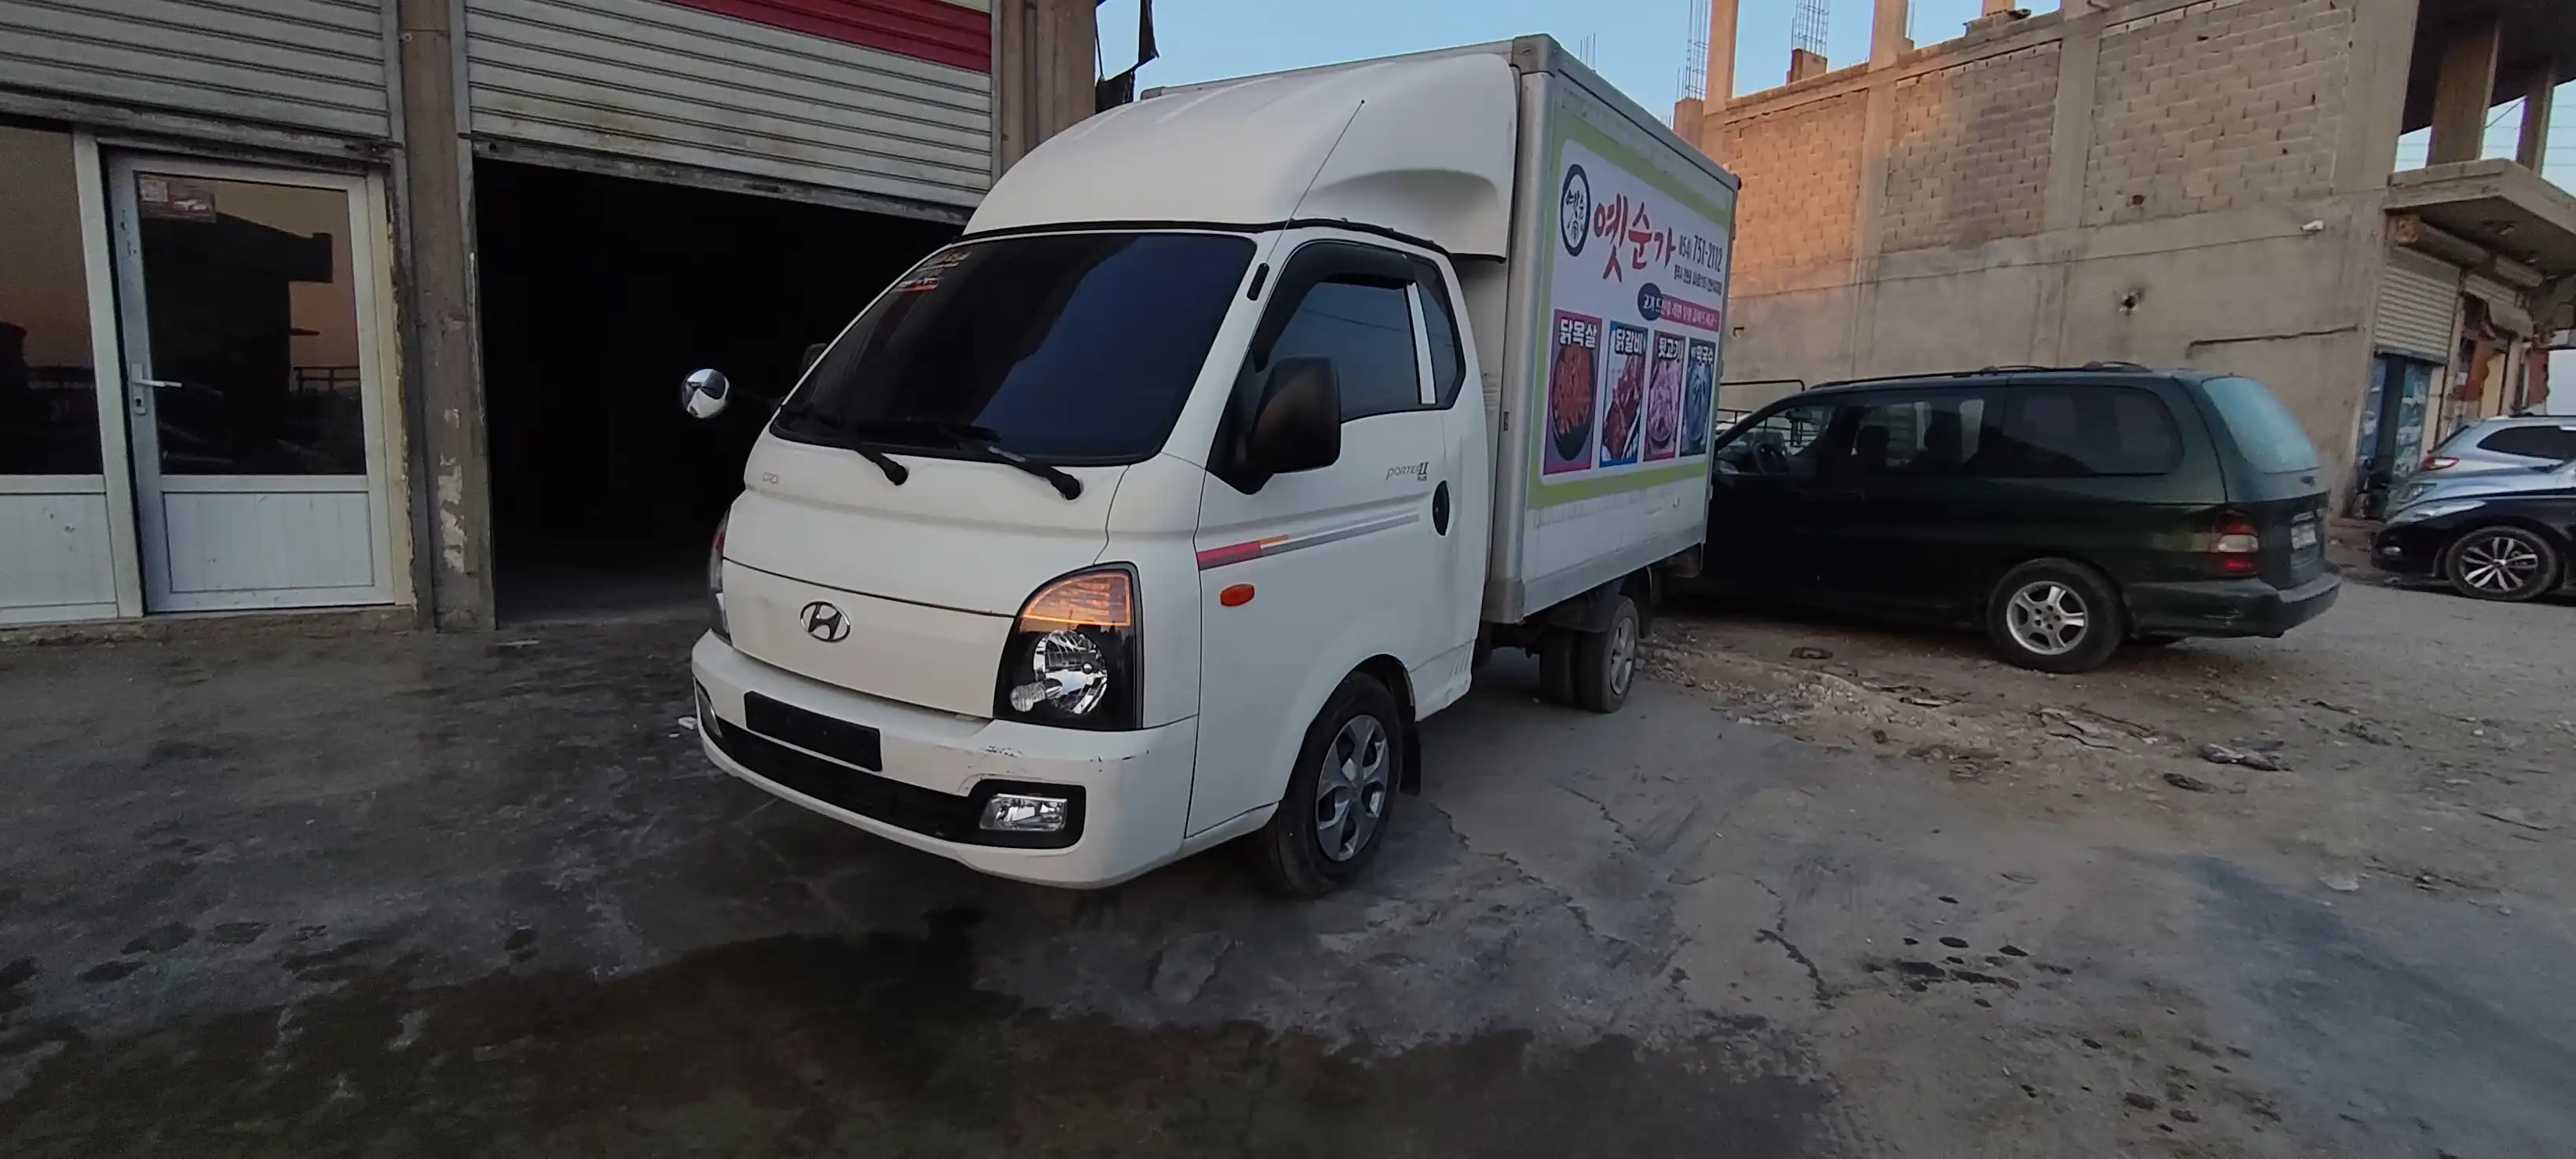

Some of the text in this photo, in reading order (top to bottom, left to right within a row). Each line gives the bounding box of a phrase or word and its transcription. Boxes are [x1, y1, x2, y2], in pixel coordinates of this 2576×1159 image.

[1693, 234, 1722, 272] 751-2112
[1559, 318, 1597, 349] 닭목살
[1615, 327, 1644, 354] 닭갈비
